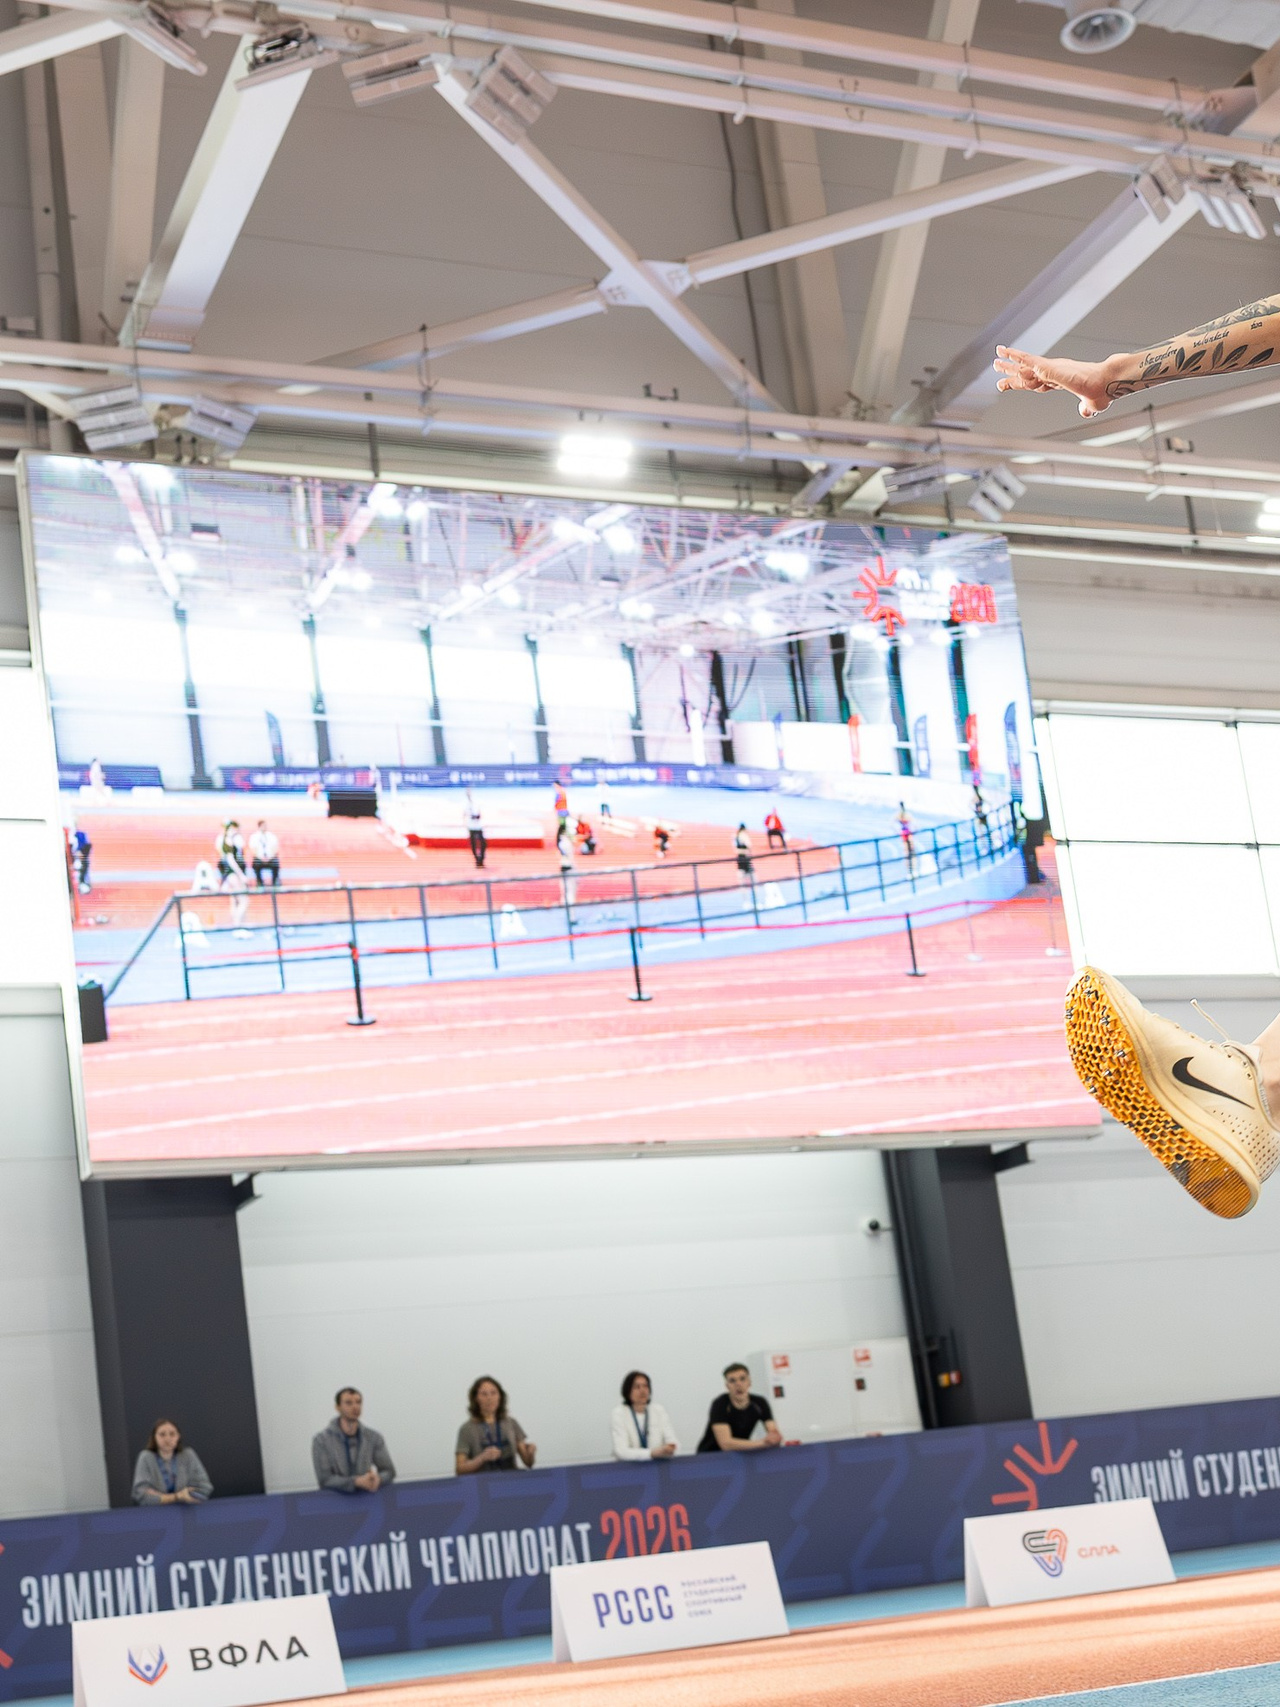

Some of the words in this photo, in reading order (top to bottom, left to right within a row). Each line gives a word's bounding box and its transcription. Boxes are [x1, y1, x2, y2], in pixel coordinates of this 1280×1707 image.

[1091, 1448, 1190, 1504] ЗИМНИЙ
[20, 1553, 159, 1629] ЗИМНИЙ
[168, 1530, 412, 1610] СТУДЕНЧЕСКИЙ
[419, 1522, 592, 1586] ЧЕМПИОНАТ
[600, 1503, 692, 1561] 2026
[592, 1584, 675, 1629] РССС
[188, 1634, 310, 1673] ВФЛА
